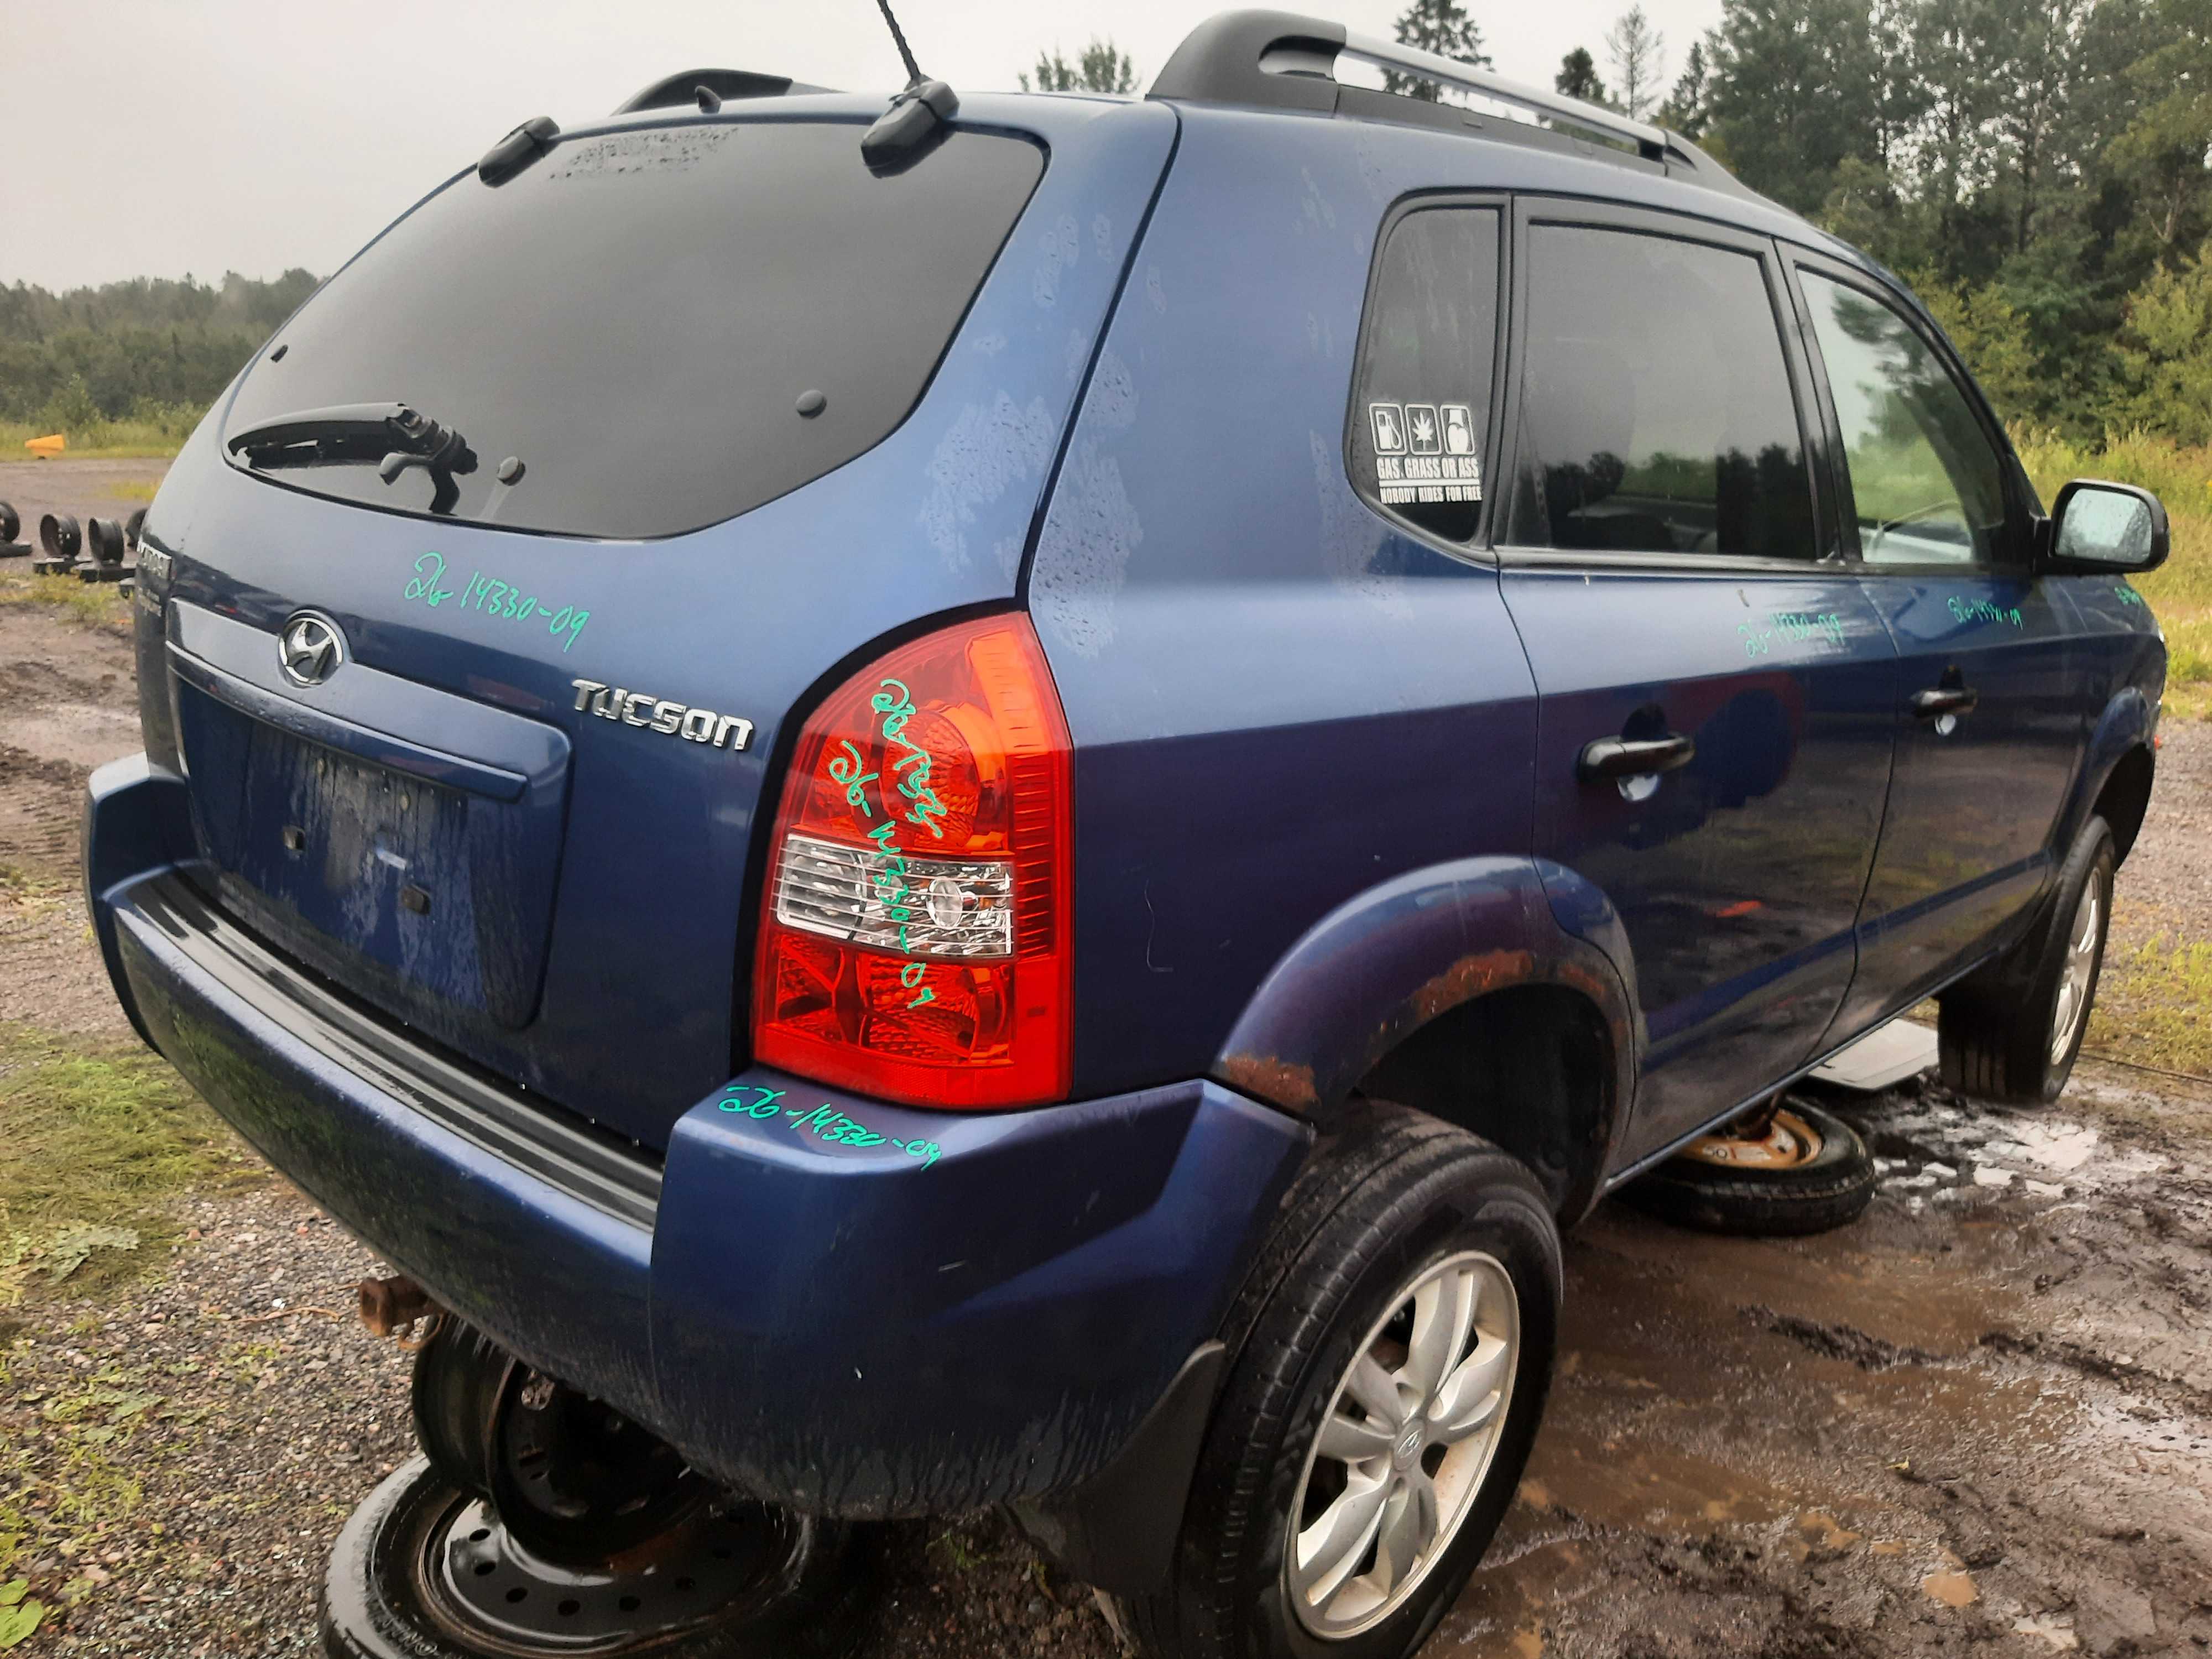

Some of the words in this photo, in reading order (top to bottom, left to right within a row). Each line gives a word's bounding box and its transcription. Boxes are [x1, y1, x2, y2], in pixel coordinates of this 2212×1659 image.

[1404, 457, 1441, 479] GRASS
[1441, 457, 1457, 478] OR
[1458, 457, 1479, 478] ASS
[1380, 487, 1416, 504] NOBODY
[1418, 486, 1444, 503] RIDES
[1445, 486, 1463, 502] FOR
[1462, 486, 1483, 501] FREE
[572, 679, 753, 750] TUCSON
